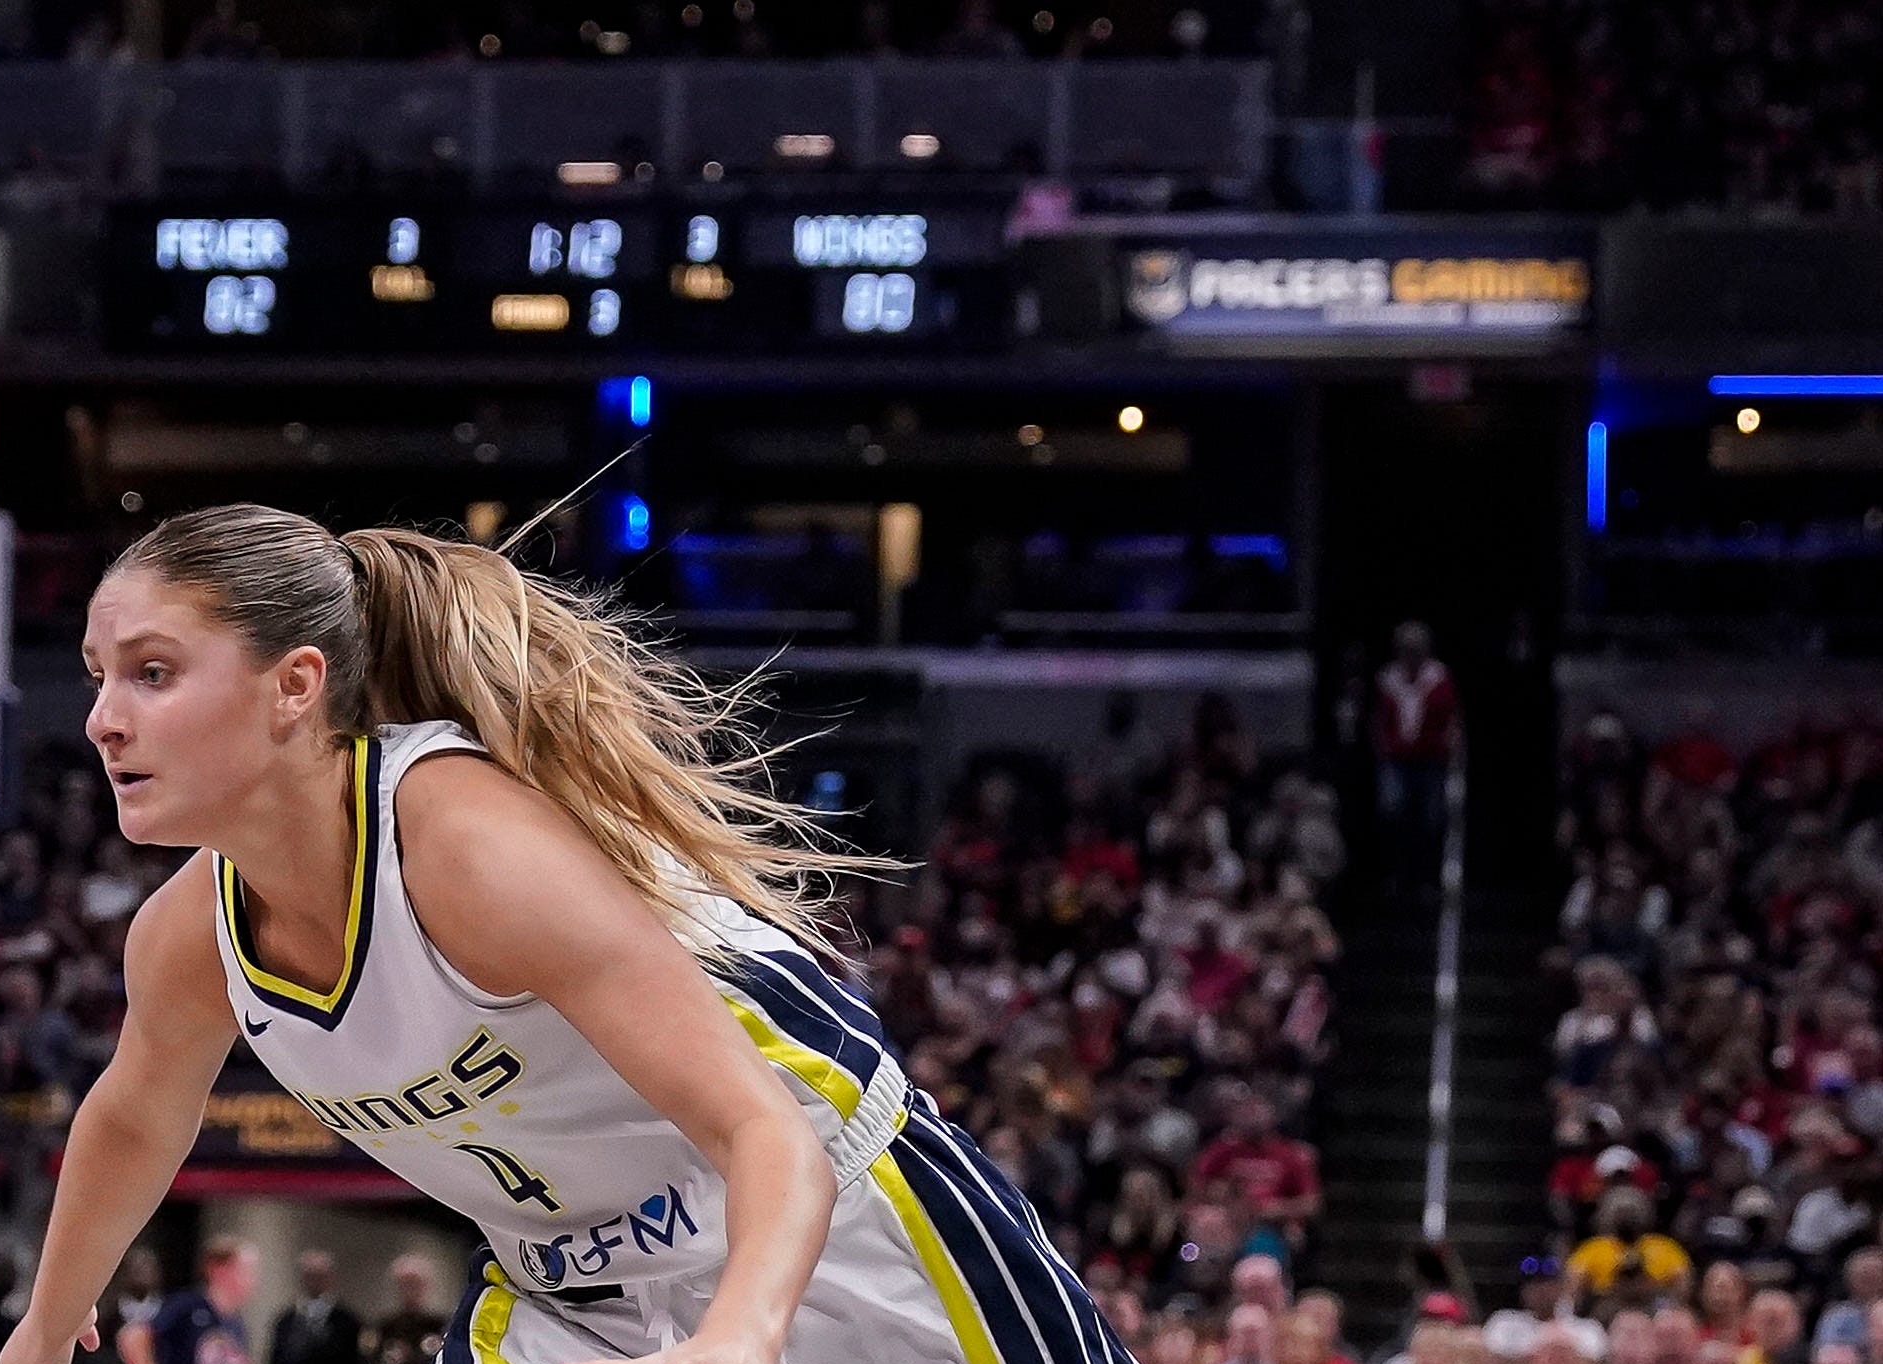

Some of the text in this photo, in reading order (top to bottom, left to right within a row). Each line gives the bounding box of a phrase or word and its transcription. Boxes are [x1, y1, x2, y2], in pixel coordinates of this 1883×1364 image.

[156, 218, 289, 271] FEVER
[793, 214, 927, 267] WINGS
[452, 1139, 565, 1216] 4
